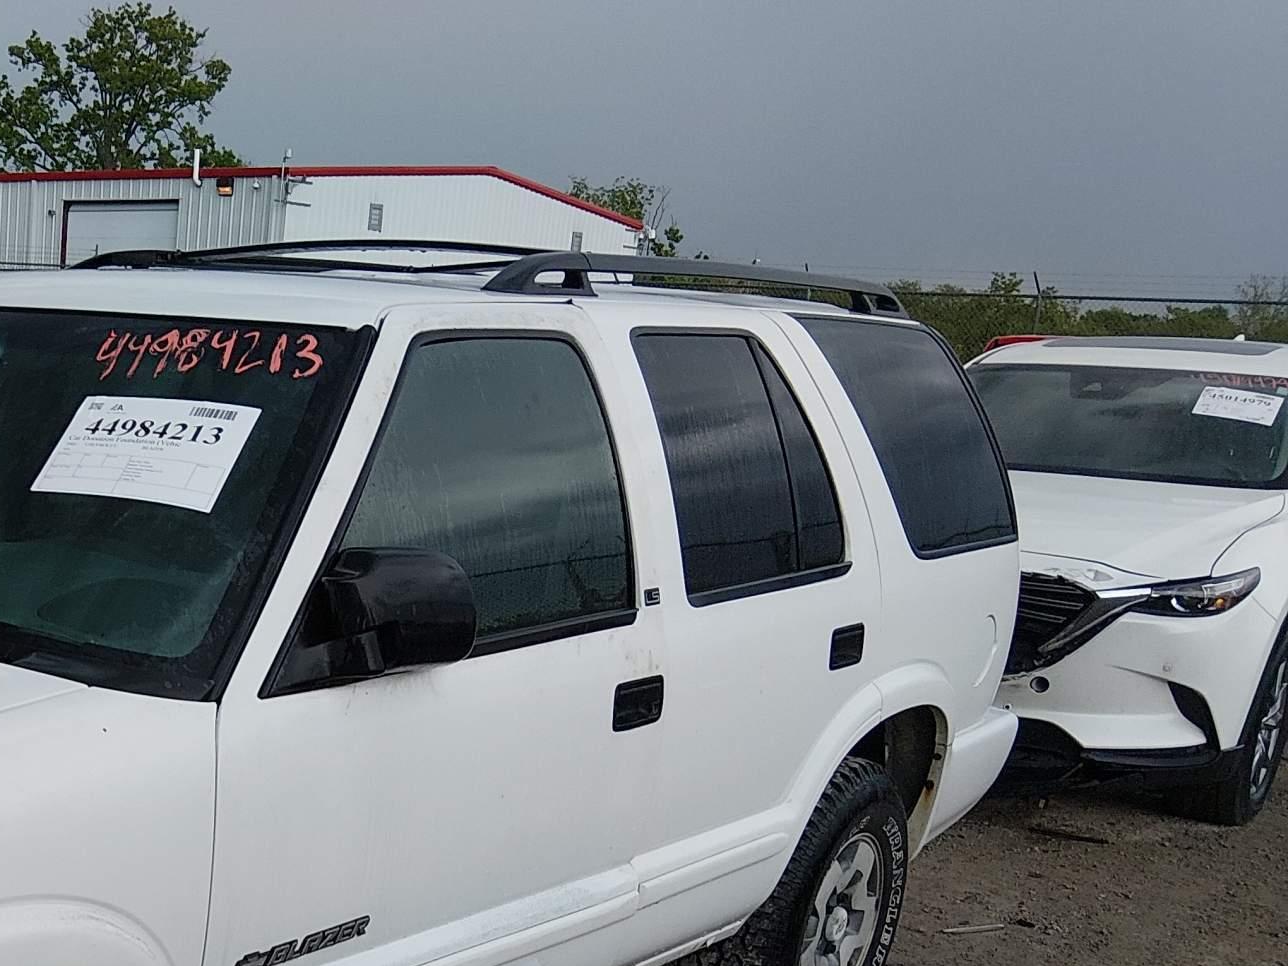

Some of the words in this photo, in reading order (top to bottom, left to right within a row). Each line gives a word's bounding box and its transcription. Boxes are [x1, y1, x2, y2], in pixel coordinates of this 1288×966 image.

[96, 327, 323, 380] 44984213
[84, 417, 224, 446] 44984213
[645, 590, 660, 604] LS
[267, 915, 371, 966] BLAZER
